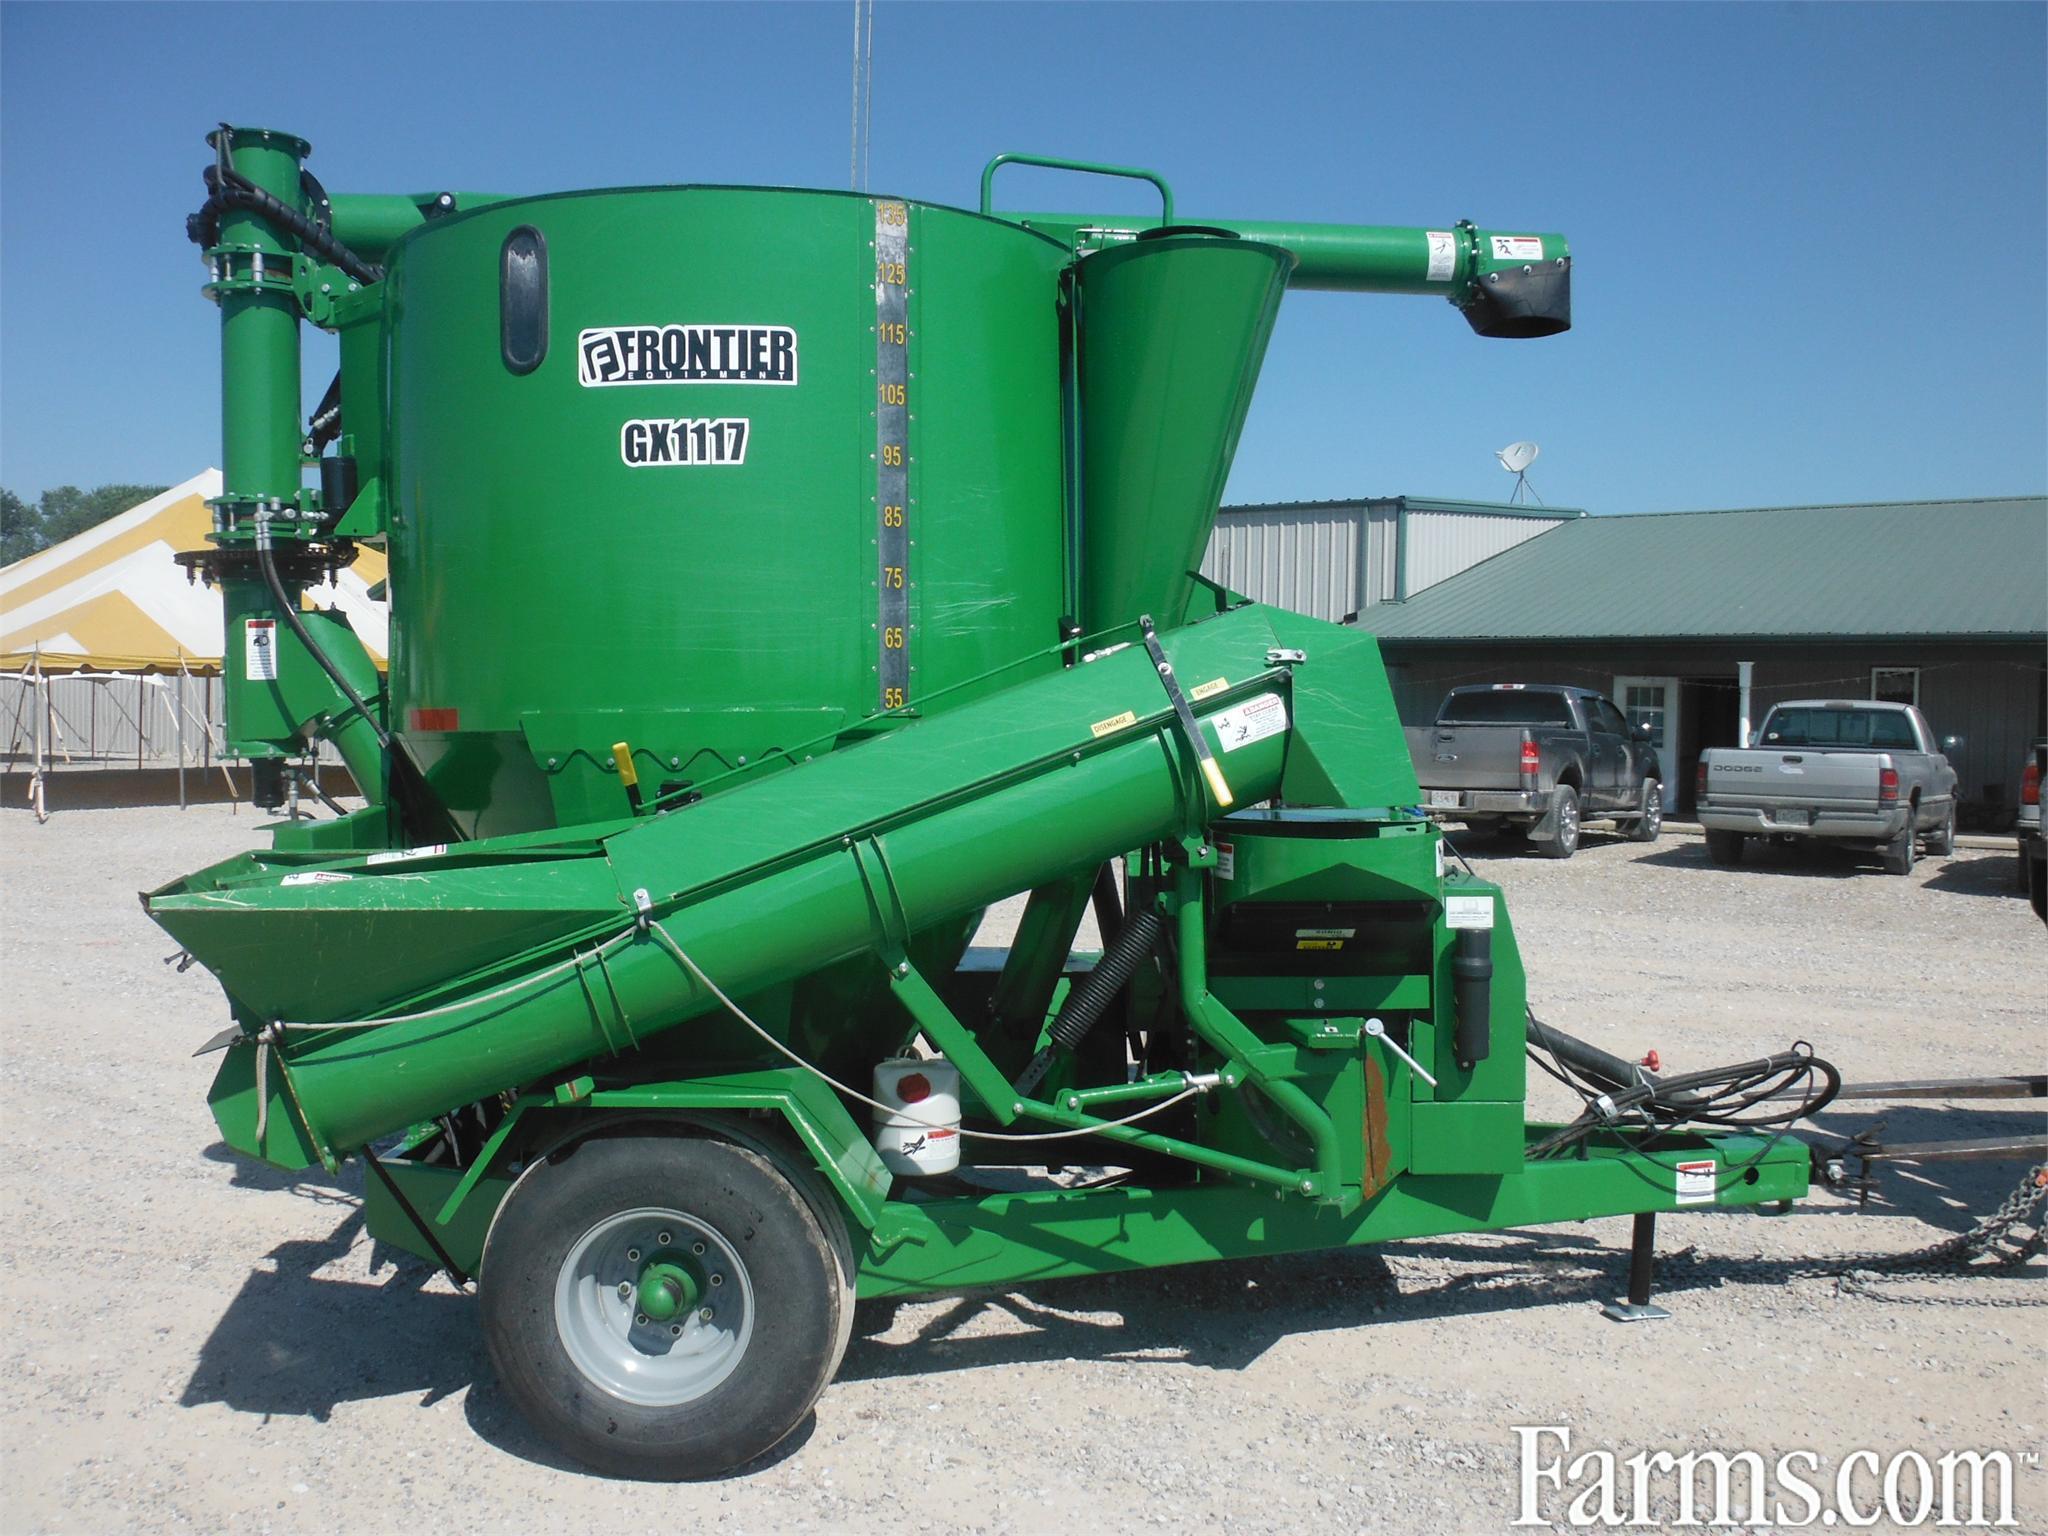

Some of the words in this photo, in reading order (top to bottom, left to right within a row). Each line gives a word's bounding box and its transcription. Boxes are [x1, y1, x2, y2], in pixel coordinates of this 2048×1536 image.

[879, 203, 905, 226] 135
[879, 263, 905, 285] 125
[880, 322, 905, 345] 115
[615, 328, 794, 374] FRONTIER
[628, 371, 787, 381] EQUIPMENT
[880, 383, 905, 406] 105
[624, 421, 746, 464] GX1117
[883, 445, 902, 467] 95
[884, 506, 903, 528] 85
[885, 567, 903, 589] 75
[885, 627, 903, 649] 65
[885, 688, 903, 709] 55
[1195, 682, 1219, 697] ENGAGE
[1093, 715, 1128, 734] DISENGAGE
[1713, 764, 1763, 773] DODGE
